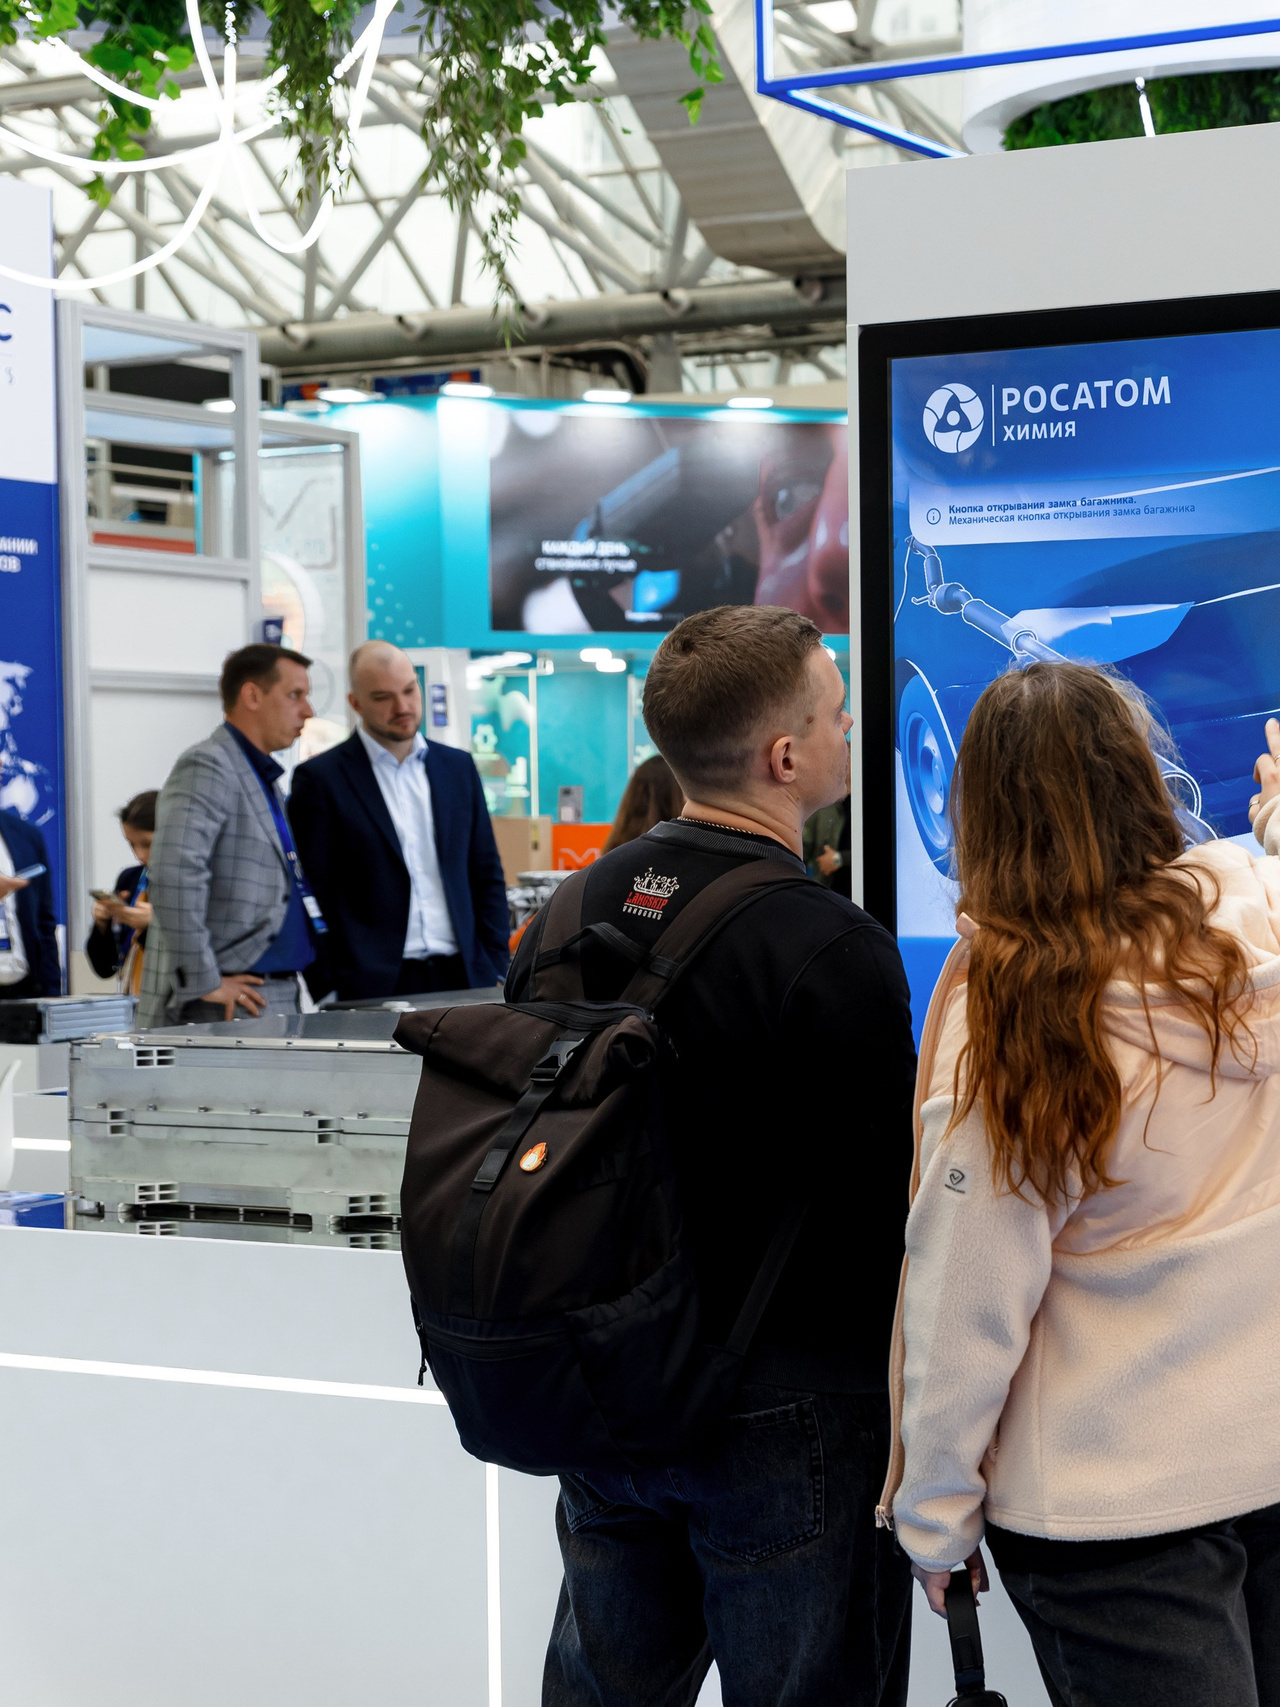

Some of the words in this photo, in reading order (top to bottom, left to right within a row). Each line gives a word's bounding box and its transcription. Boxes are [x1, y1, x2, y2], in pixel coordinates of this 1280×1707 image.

[1002, 376, 1171, 415] РОСАТОМ
[1003, 421, 1076, 441] ХИМИЯ
[948, 505, 984, 514] Кнопка
[986, 501, 1045, 514] открывания
[1048, 500, 1077, 509] замка
[1080, 496, 1136, 507] багажника.
[948, 514, 1015, 525] Механическая
[1017, 511, 1050, 521] кнопка
[1053, 508, 1110, 521] открывания
[1113, 507, 1141, 517] замка
[1143, 504, 1196, 515] багажника
